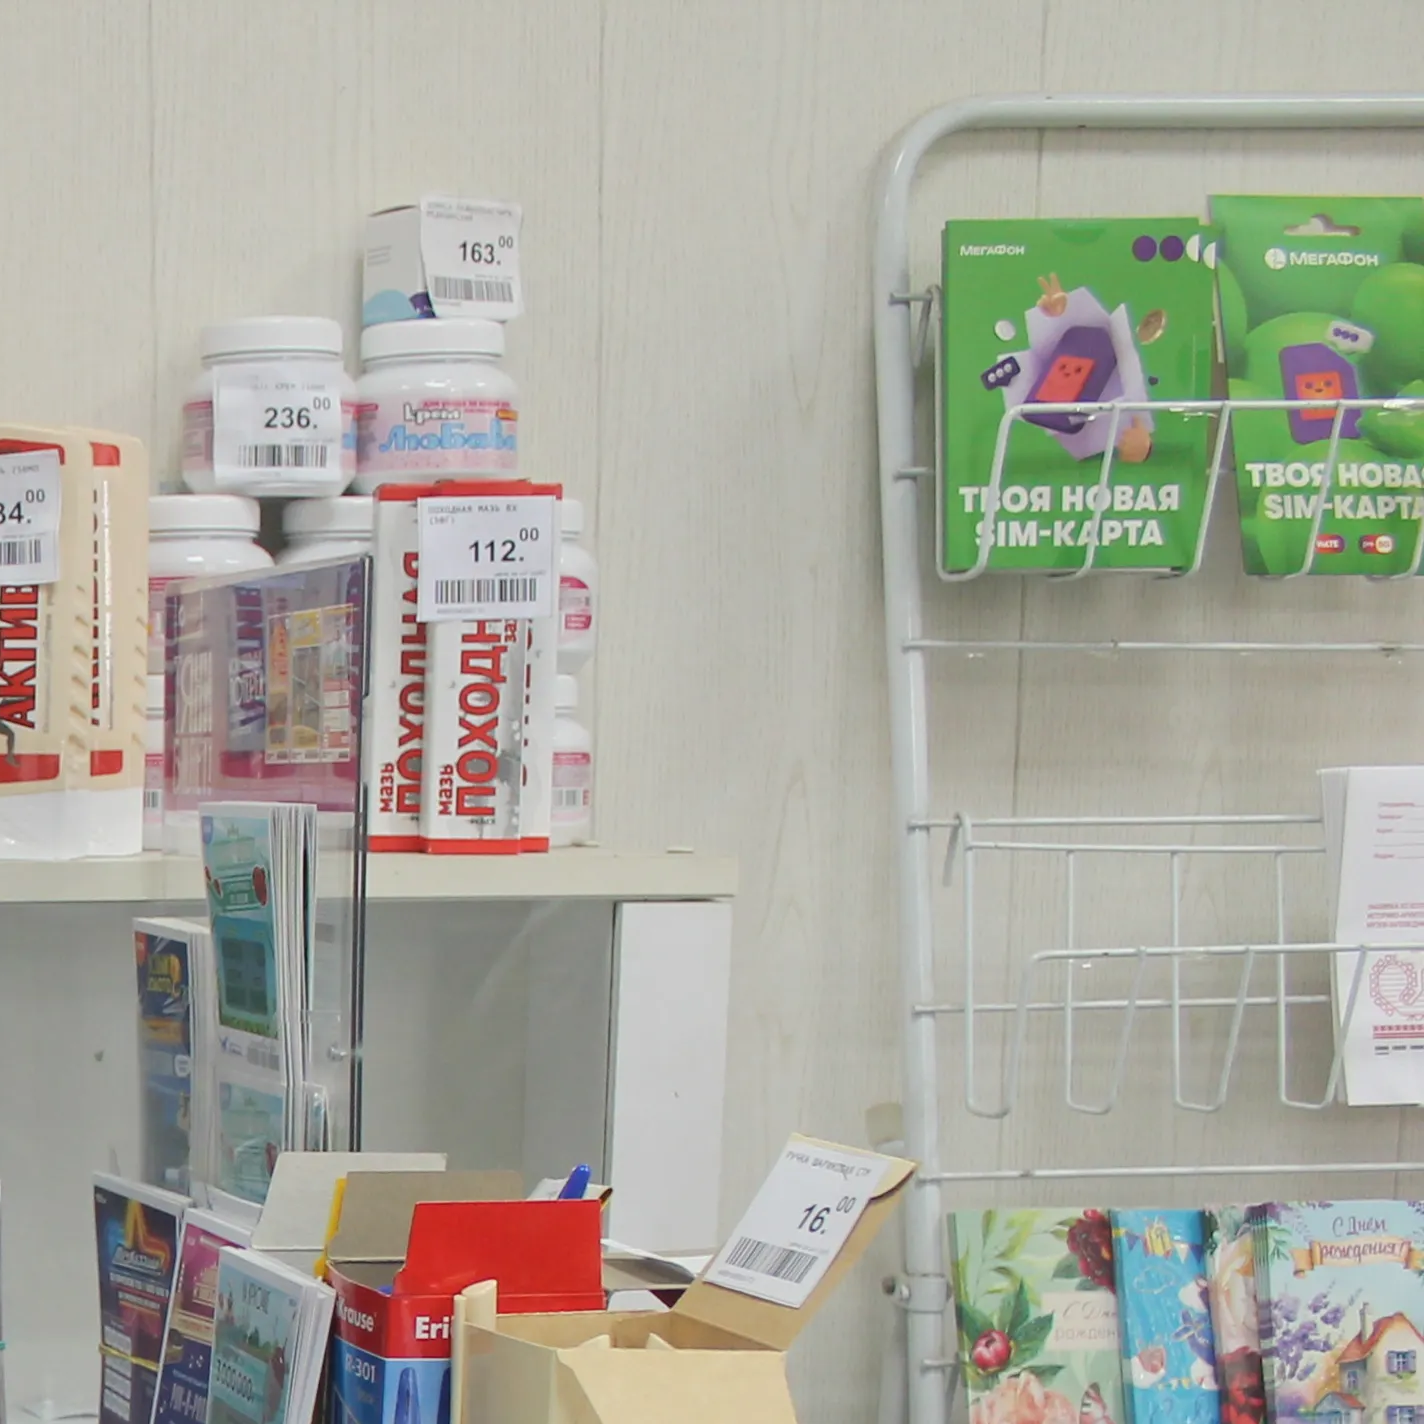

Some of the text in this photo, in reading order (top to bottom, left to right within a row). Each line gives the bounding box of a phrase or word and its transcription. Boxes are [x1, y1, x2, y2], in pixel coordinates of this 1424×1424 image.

[958, 484, 1180, 513] ТВОЯ НОВАЯ
[455, 619, 509, 817] ПОХОДН
[379, 762, 395, 814] мазь
[438, 763, 454, 816] мазь
[415, 1315, 453, 1340] Eri
